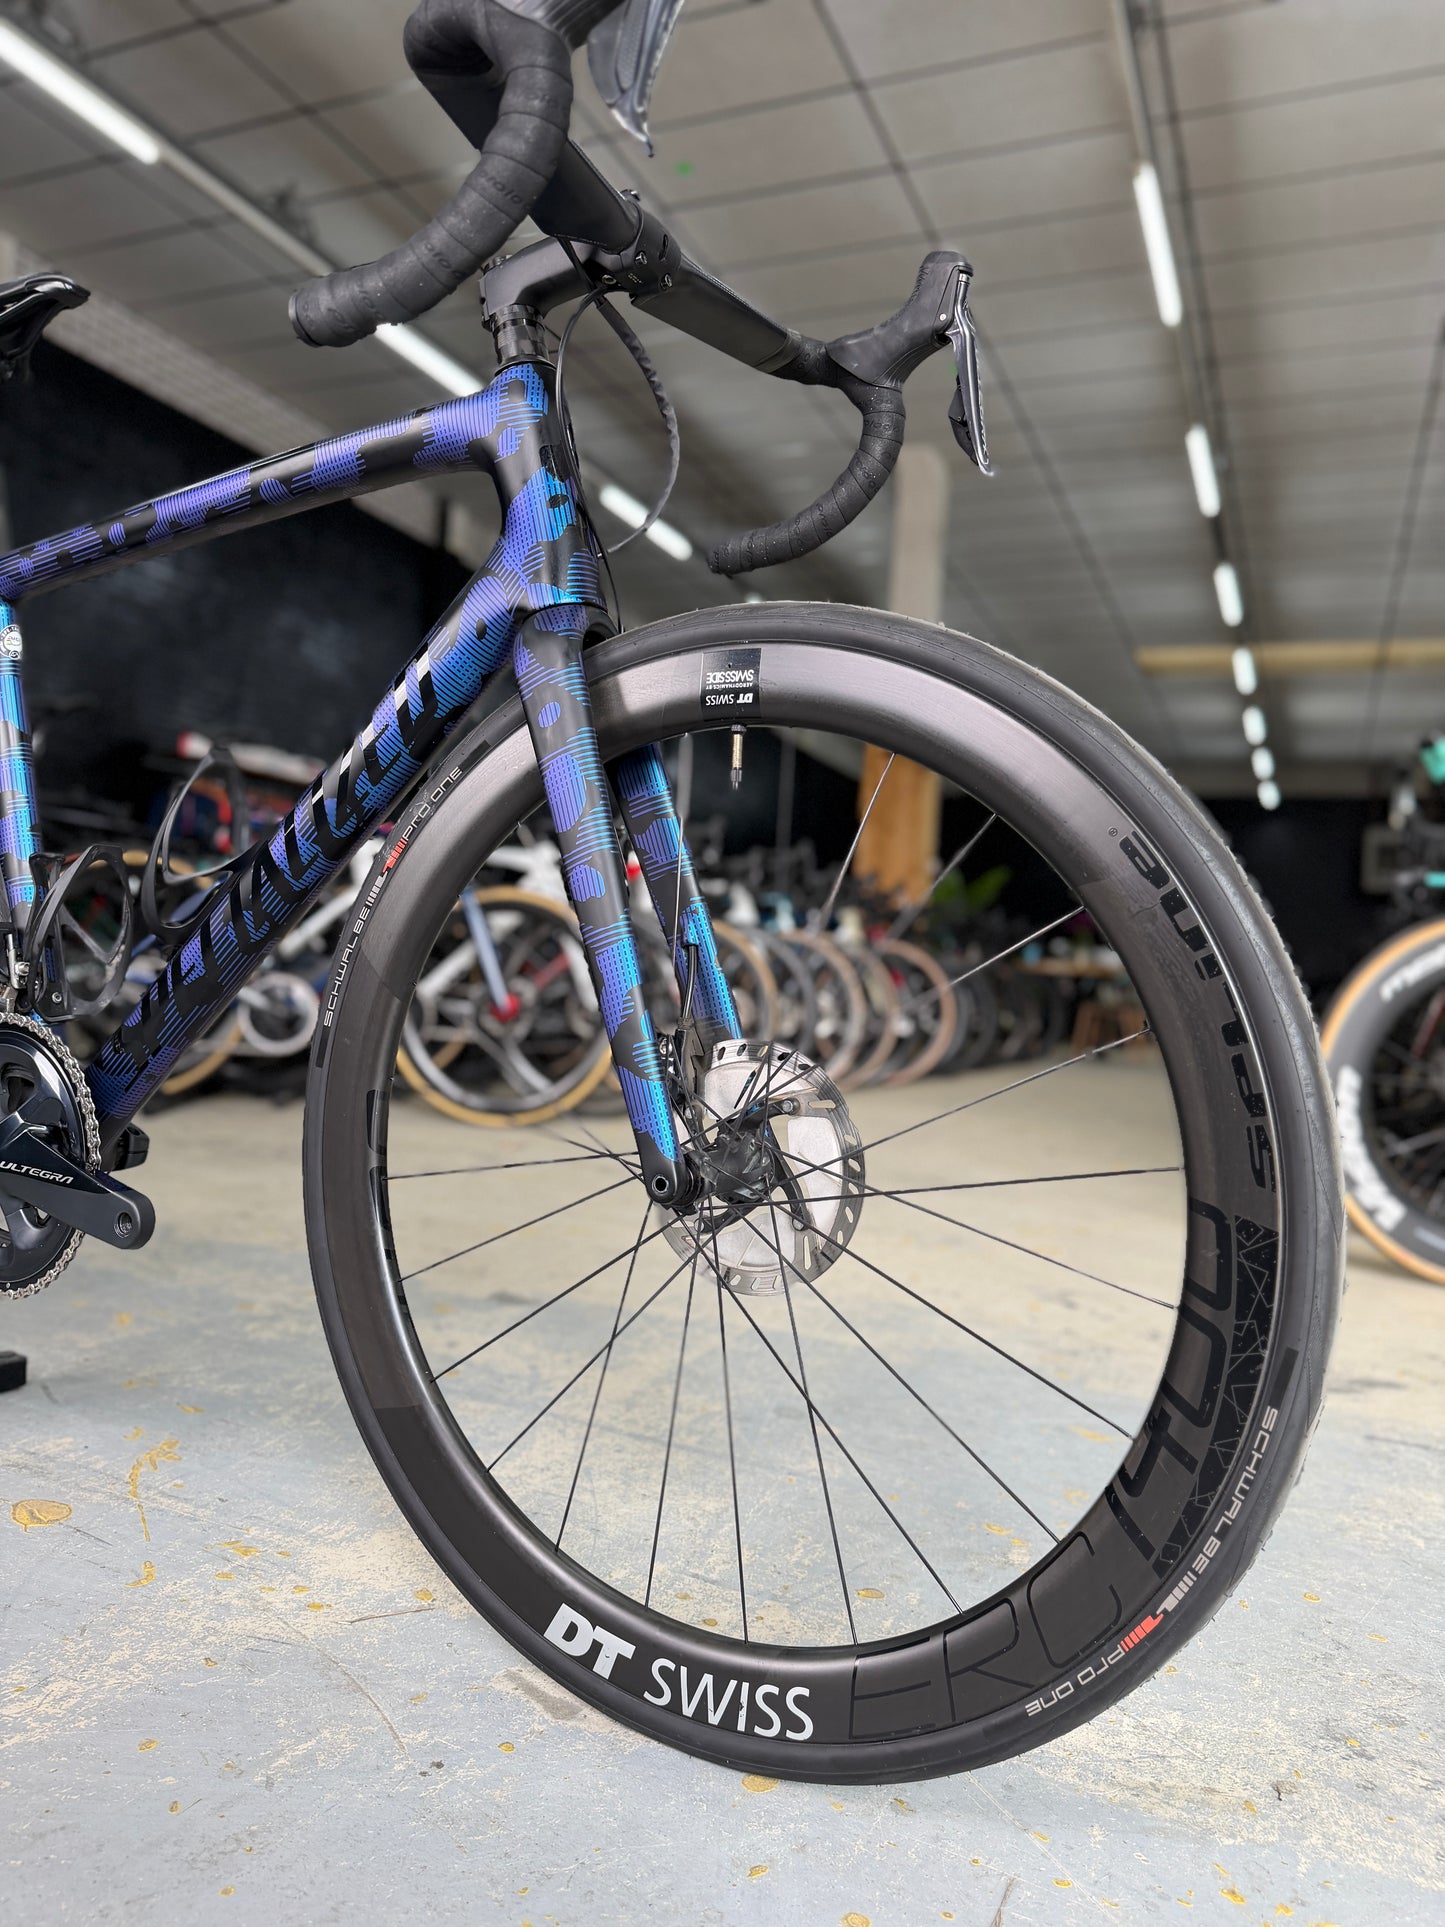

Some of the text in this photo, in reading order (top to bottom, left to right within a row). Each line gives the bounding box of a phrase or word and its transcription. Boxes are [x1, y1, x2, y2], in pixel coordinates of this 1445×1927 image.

[705, 692, 754, 706] DT SWISS
[713, 682, 753, 690] AERODYNAMICS
[323, 904, 371, 1027] SCHWALBE
[1119, 831, 1278, 1193] spline
[0, 1160, 74, 1185] ULTEGRA
[1191, 1405, 1279, 1576] SCHWALBE
[543, 1602, 814, 1741] DT SWISS
[848, 1530, 1122, 1740] ERC
